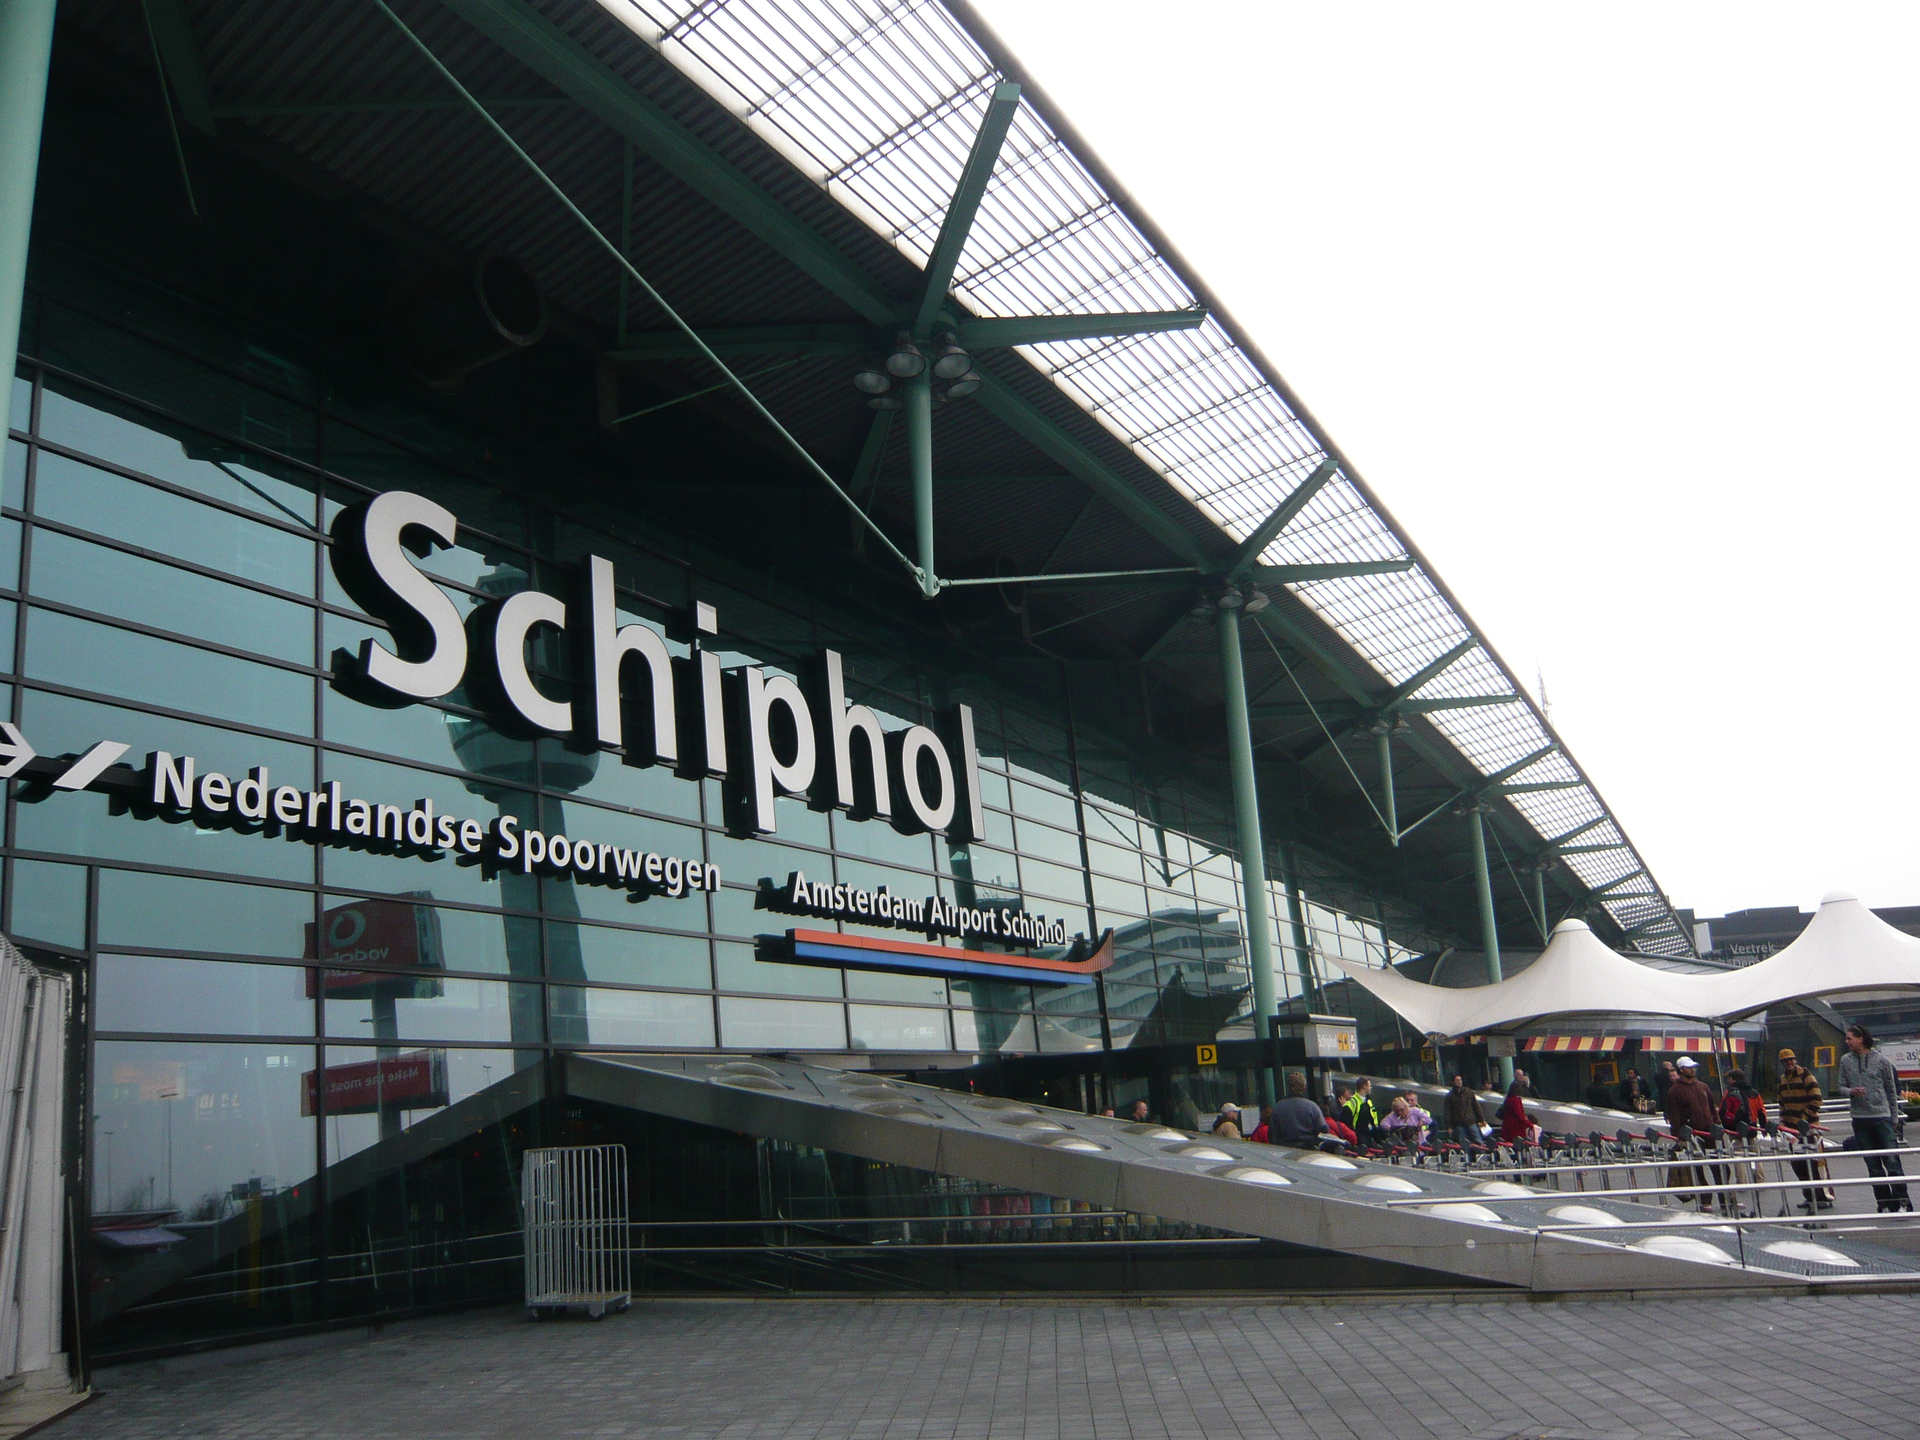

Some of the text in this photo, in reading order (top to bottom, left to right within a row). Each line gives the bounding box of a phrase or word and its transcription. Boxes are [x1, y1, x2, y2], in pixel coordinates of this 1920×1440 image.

[359, 490, 985, 842] Schiphol
[153, 750, 722, 898] Nederlandse Spoorwegen
[793, 870, 1067, 948] Amsterdam Airport Schiphol
[1730, 941, 1774, 955] Vertrek
[1200, 1047, 1214, 1062] D
